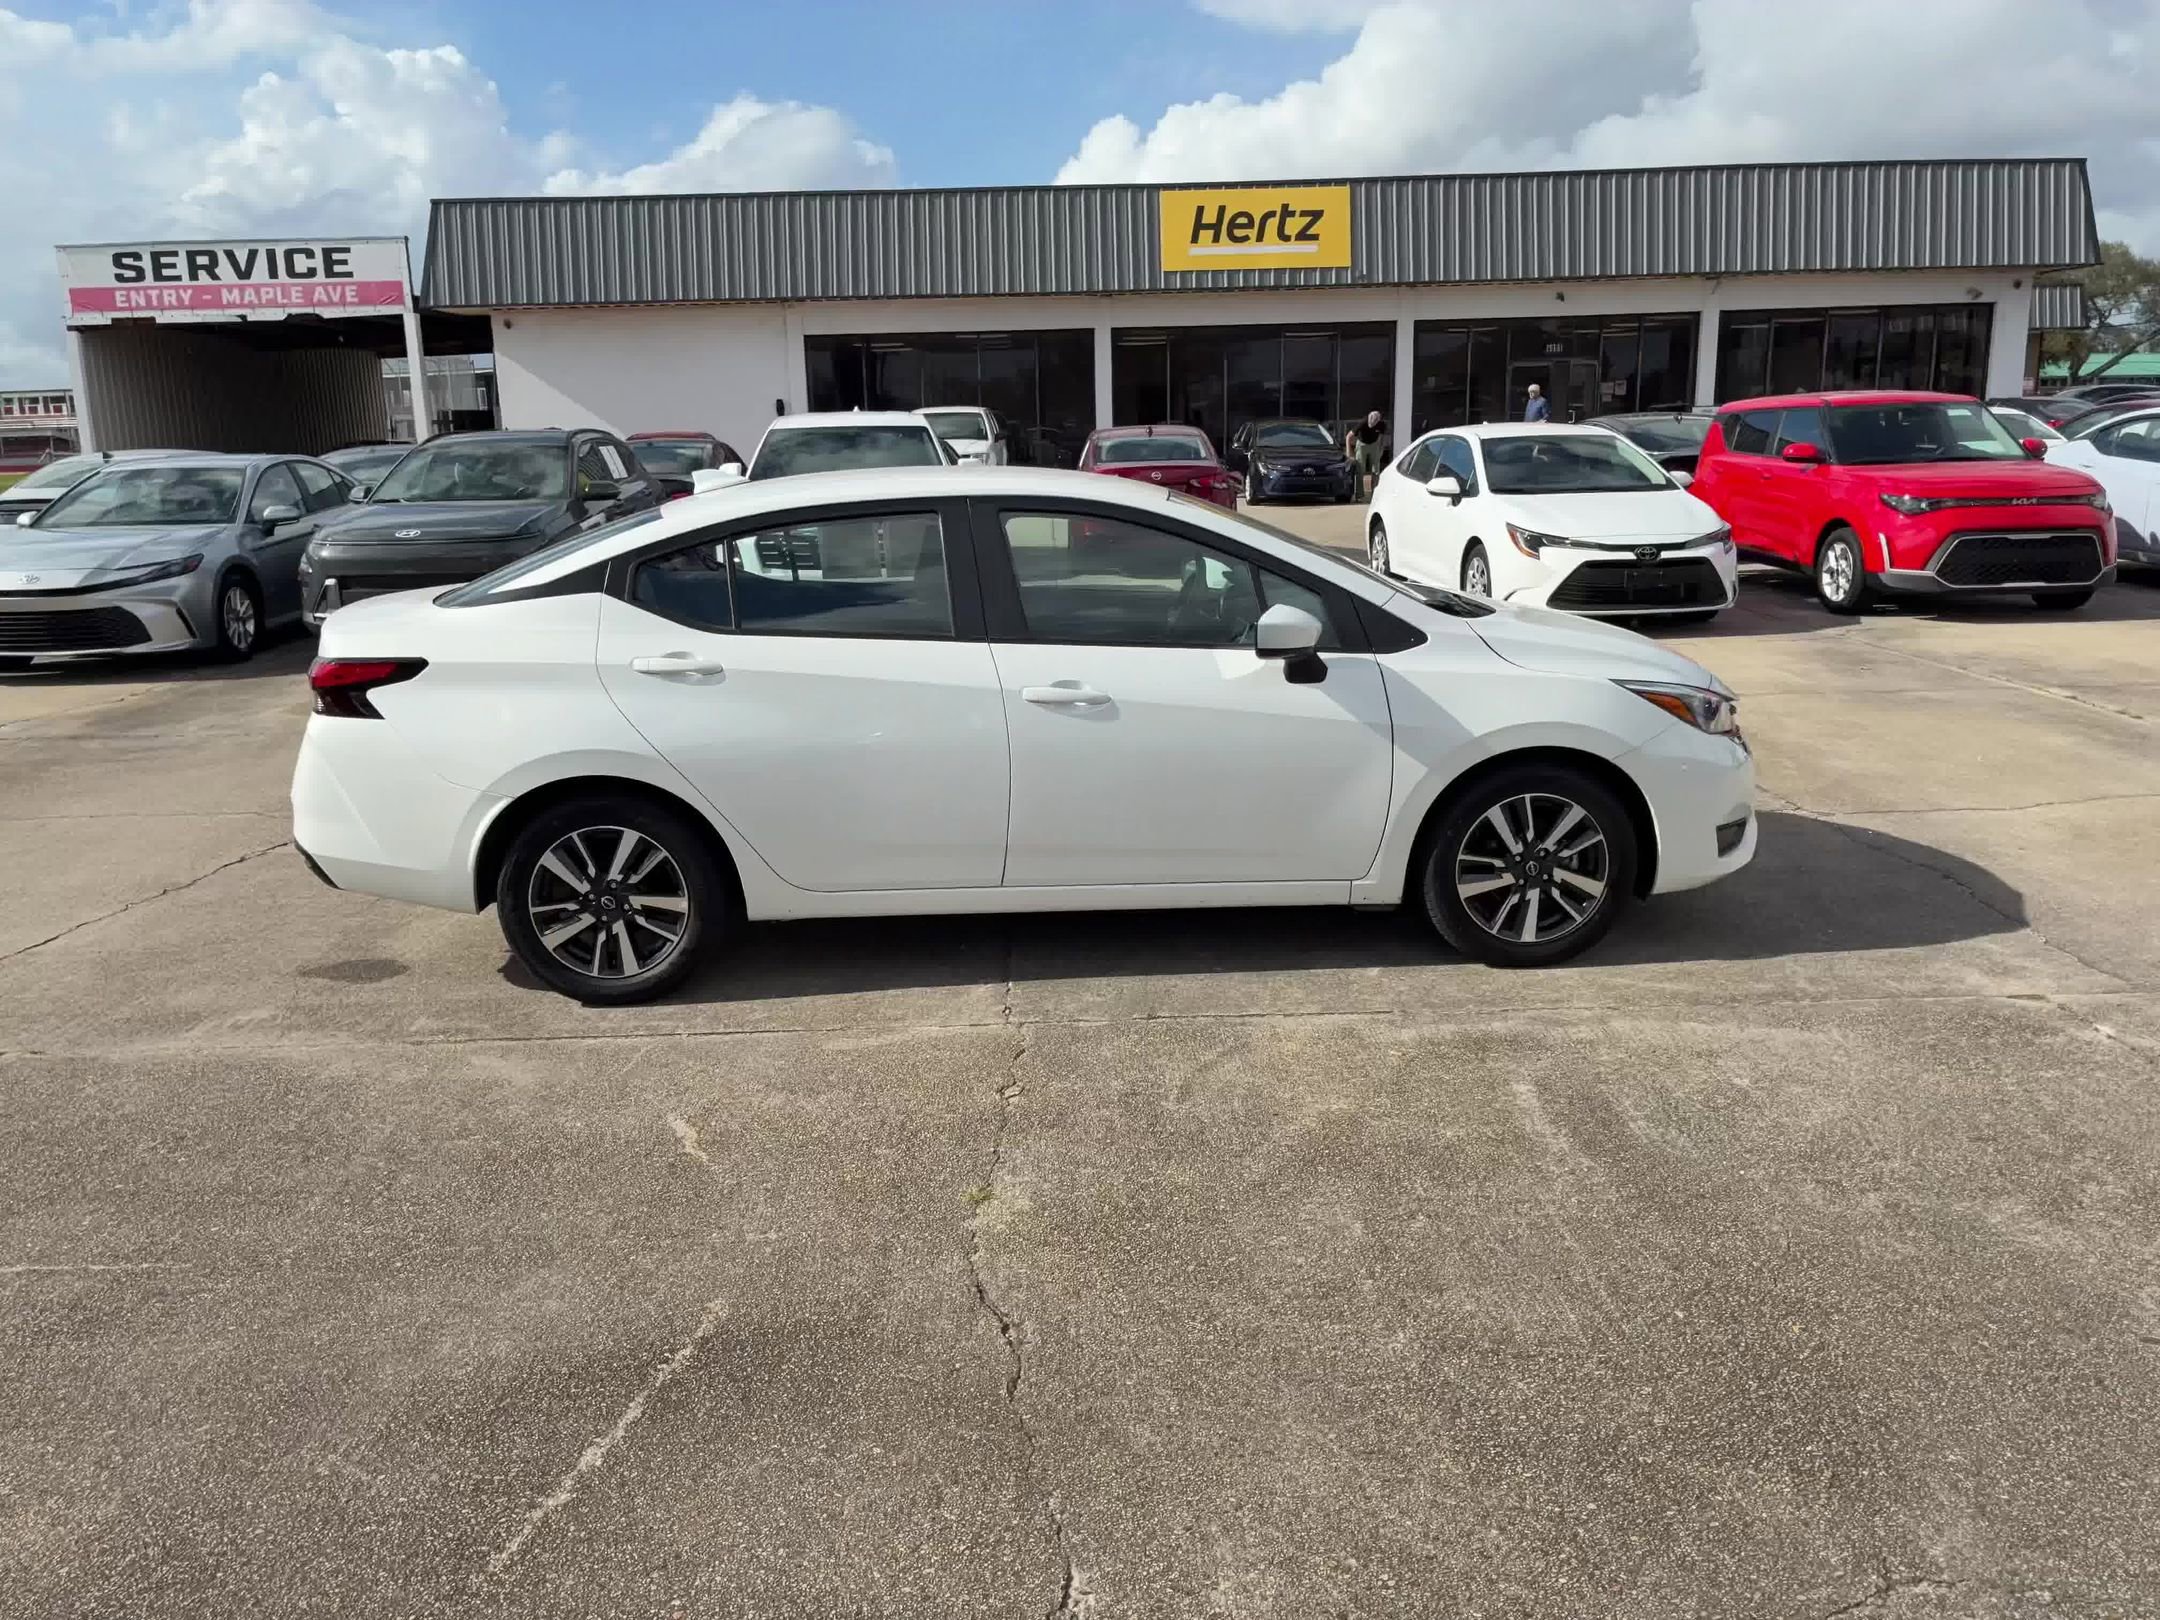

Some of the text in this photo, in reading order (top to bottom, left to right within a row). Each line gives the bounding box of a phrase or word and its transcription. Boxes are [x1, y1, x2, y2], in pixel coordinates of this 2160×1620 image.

[1191, 203, 1324, 244] Hertz
[112, 247, 354, 283] SERVICE
[115, 289, 192, 308] ENTRY
[221, 286, 304, 305] MAPLE
[313, 285, 359, 303] AVE
